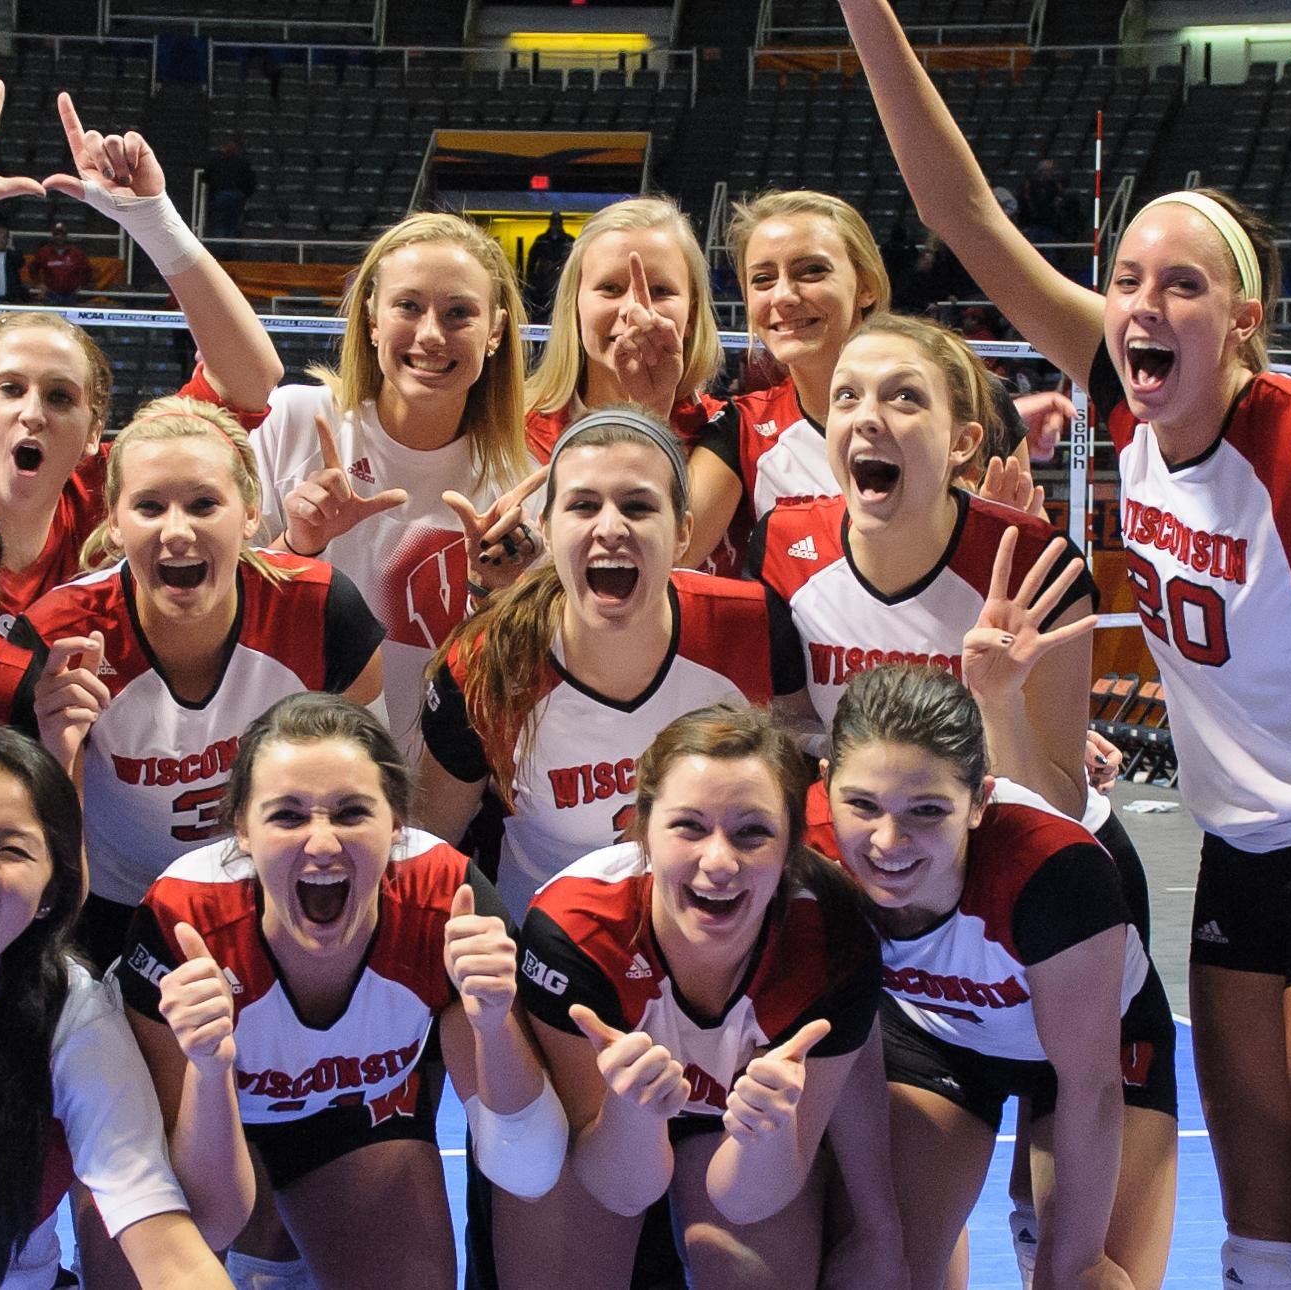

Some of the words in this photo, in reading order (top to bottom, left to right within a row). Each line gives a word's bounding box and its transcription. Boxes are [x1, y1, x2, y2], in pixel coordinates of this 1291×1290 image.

[78, 311, 104, 320] NCAA
[1073, 409, 1086, 469] senoh
[1125, 546, 1231, 668] 20
